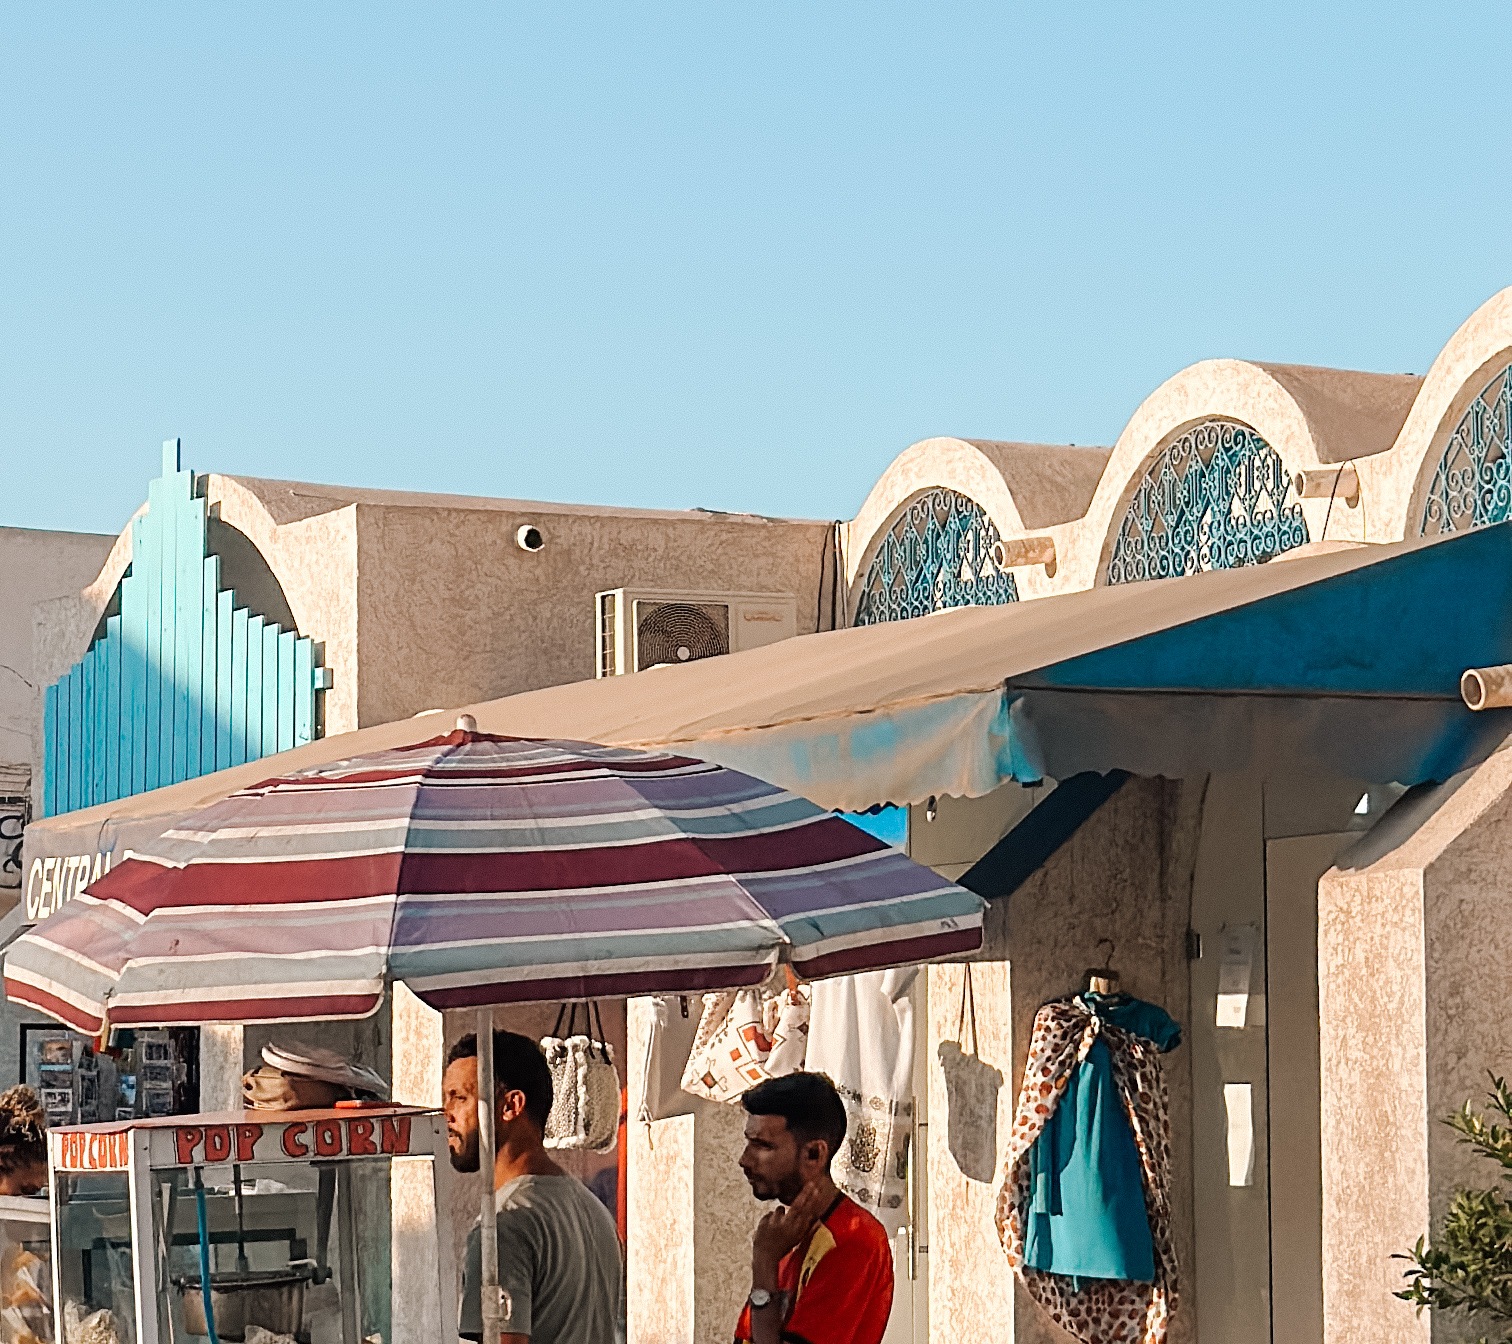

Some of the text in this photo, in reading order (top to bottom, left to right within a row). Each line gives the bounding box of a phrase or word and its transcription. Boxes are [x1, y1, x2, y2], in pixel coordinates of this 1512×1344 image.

[61, 1132, 86, 1169] POP
[174, 1116, 412, 1165] POP CORN
